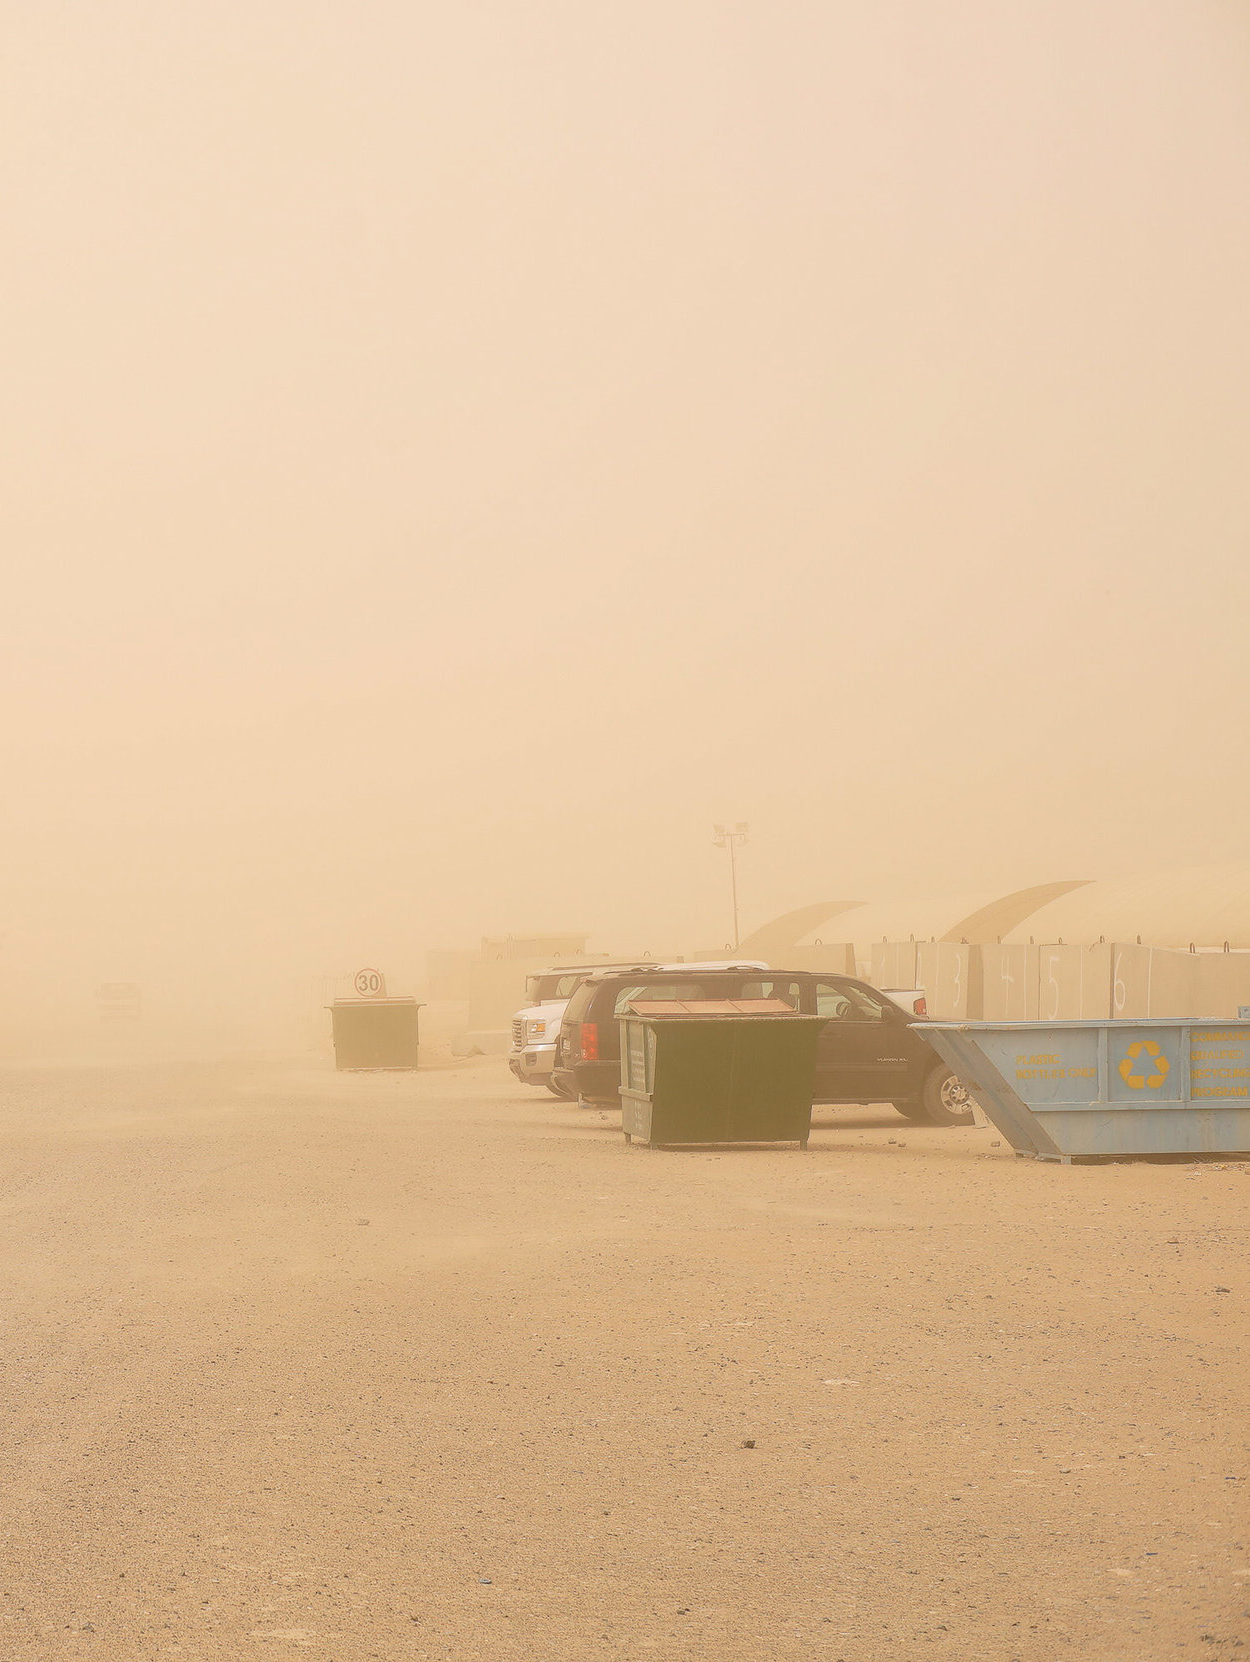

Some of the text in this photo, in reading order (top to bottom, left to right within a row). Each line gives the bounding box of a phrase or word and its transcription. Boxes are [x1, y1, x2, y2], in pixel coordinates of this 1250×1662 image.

[358, 974, 379, 991] 30
[953, 953, 962, 1008] 3
[1000, 955, 1015, 1019] 4
[1048, 956, 1060, 1020] 5
[1114, 952, 1126, 1010] 6
[1015, 1054, 1061, 1065] PLASTIC
[1015, 1069, 1065, 1080] BOTTLES
